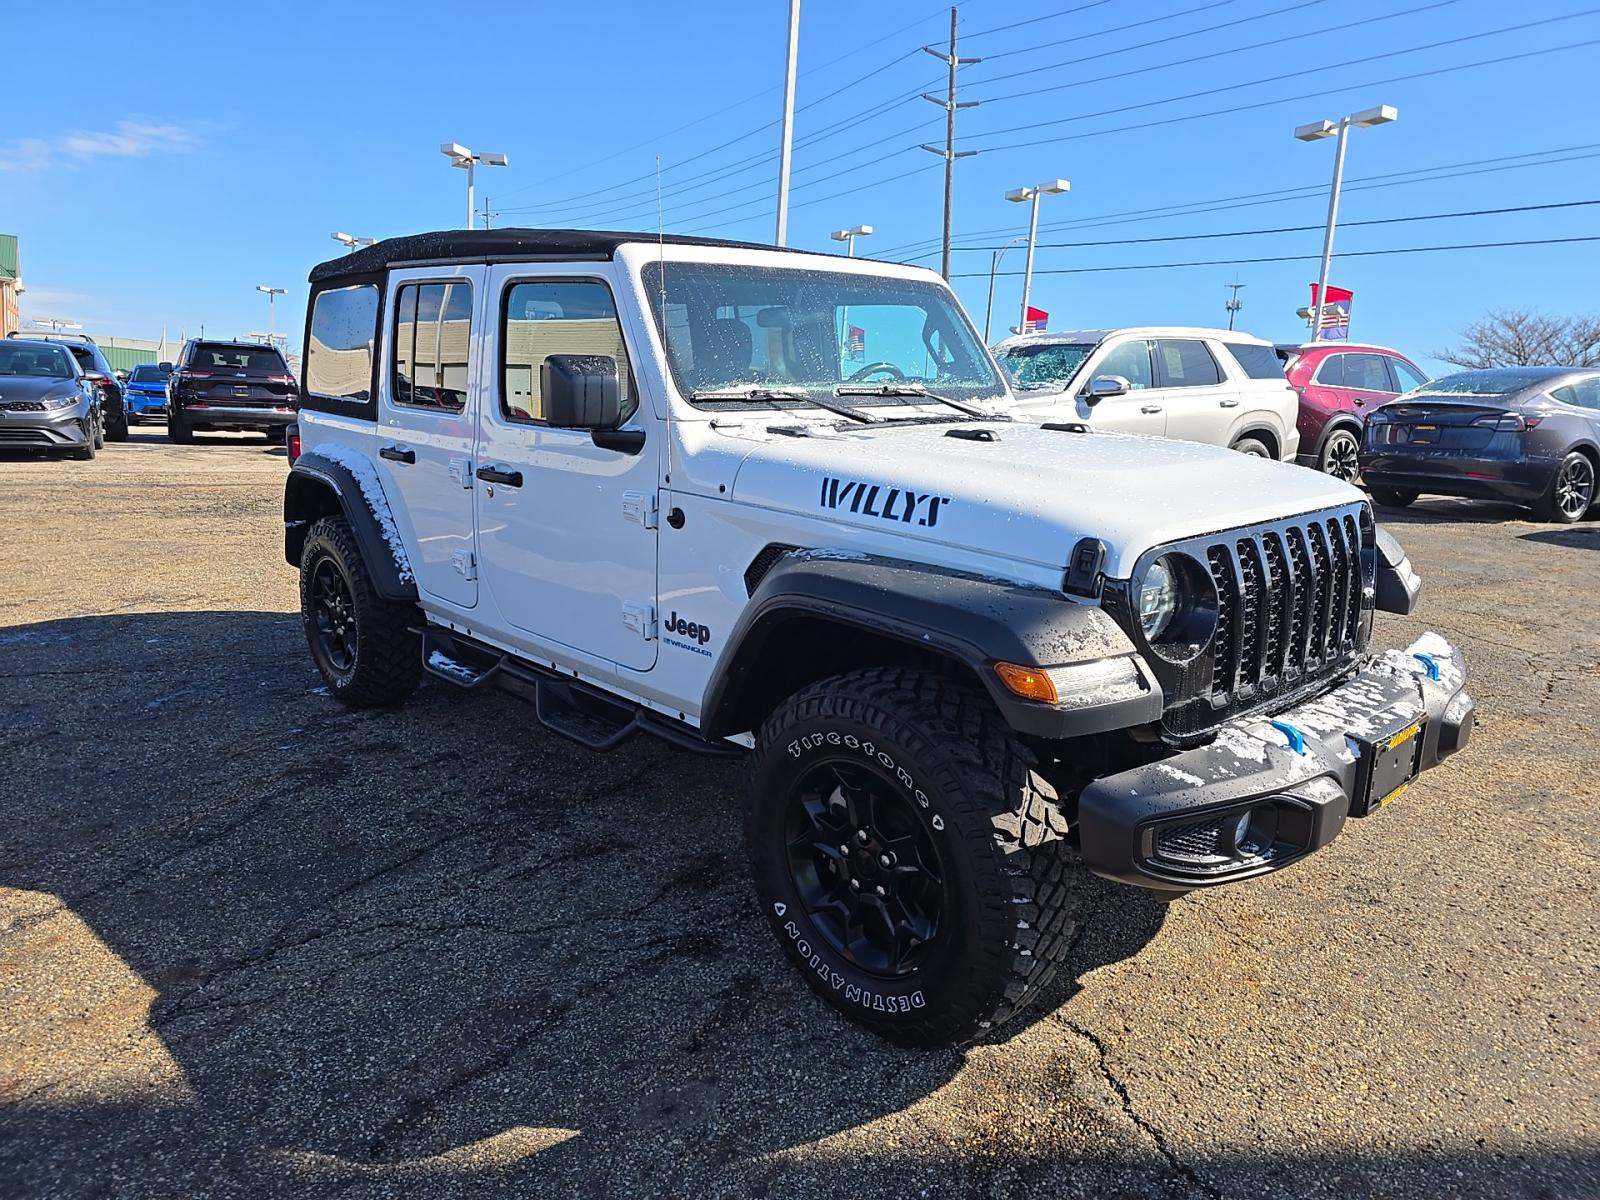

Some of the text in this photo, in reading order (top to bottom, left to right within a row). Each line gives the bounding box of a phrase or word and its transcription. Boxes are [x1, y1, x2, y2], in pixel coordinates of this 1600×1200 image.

[820, 477, 950, 527] WILLYS
[664, 611, 711, 645] Jeep
[784, 920, 926, 1013] DESTINATION
